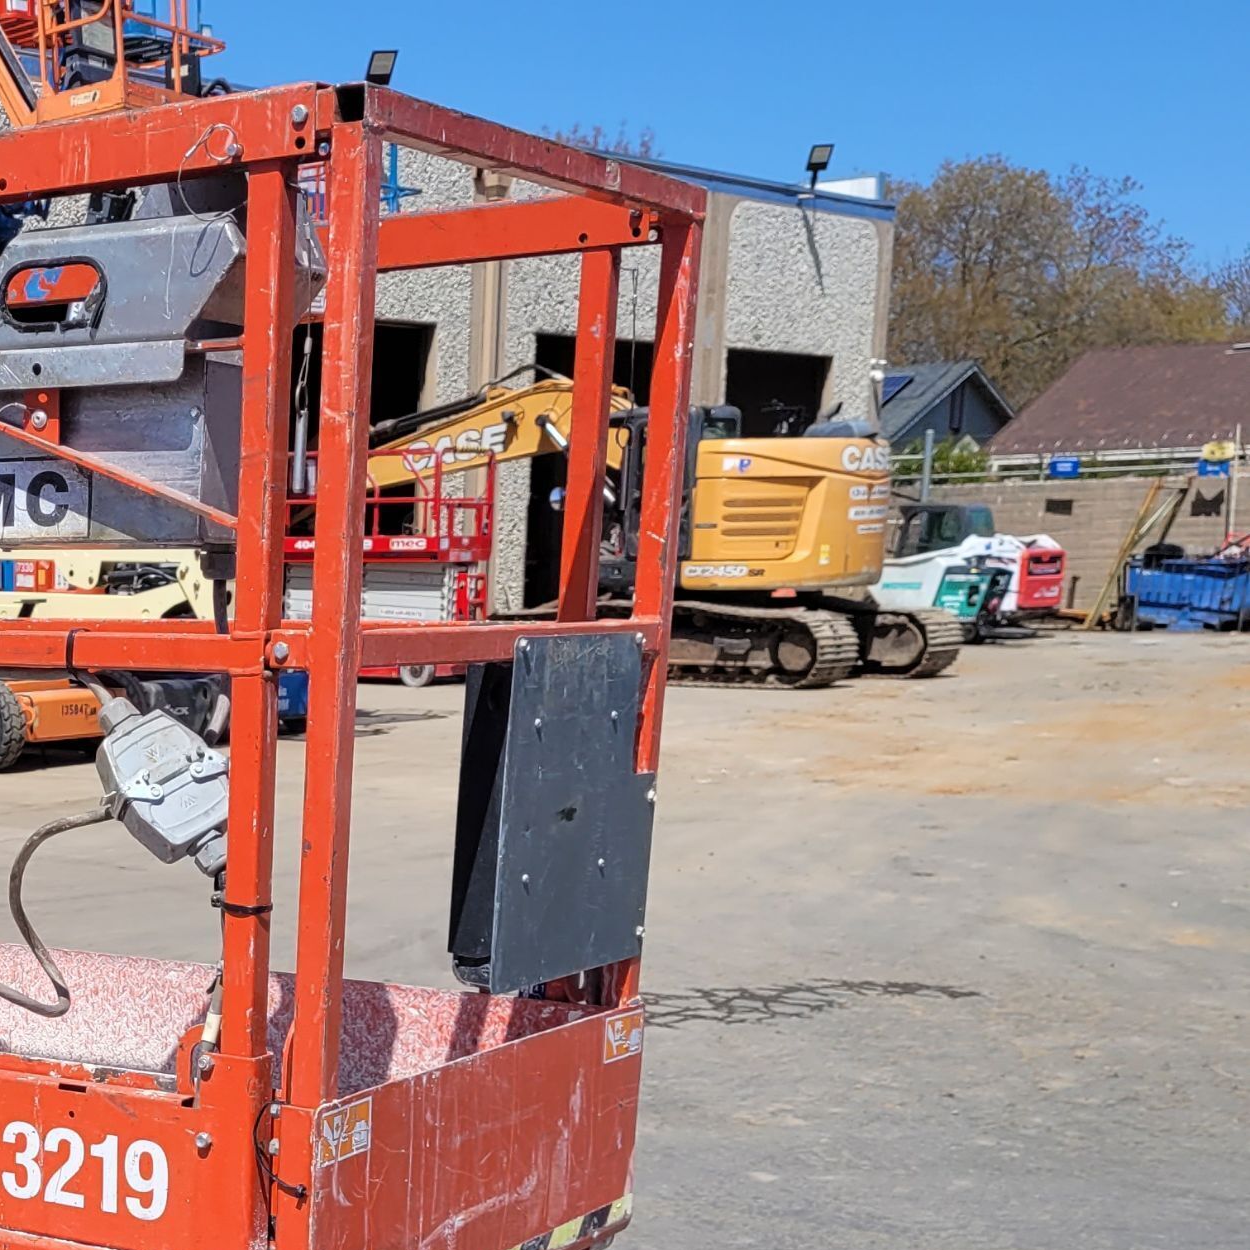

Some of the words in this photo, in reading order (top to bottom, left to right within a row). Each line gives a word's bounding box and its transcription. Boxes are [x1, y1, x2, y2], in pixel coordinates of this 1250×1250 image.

[403, 423, 508, 472] CASE
[391, 539, 427, 548] mec
[1, 1120, 169, 1221] 3219
